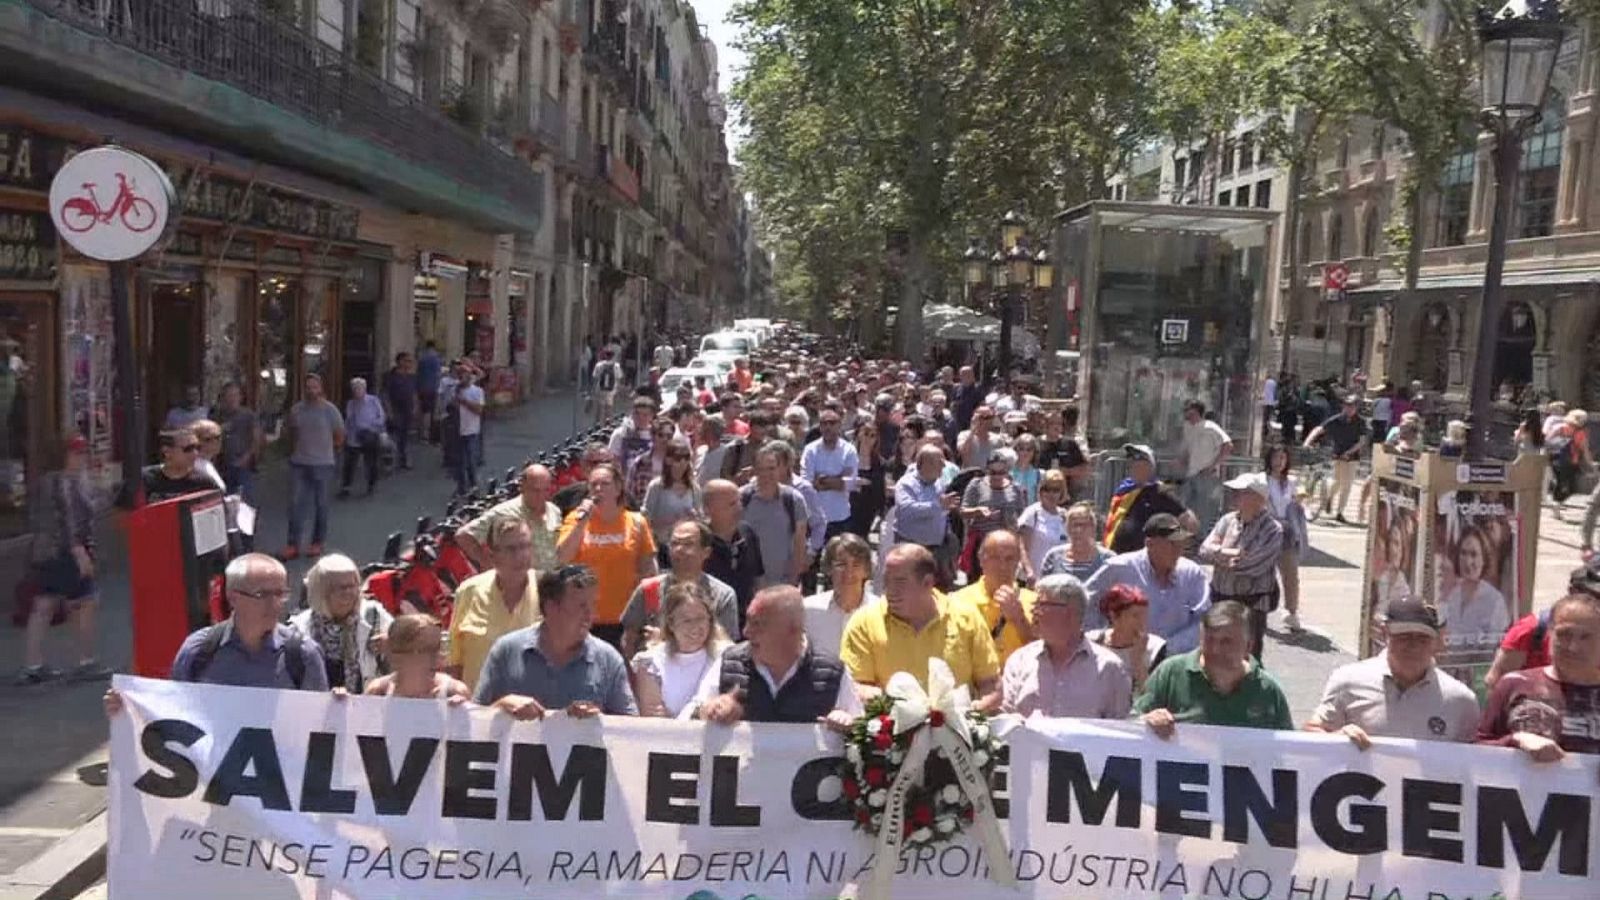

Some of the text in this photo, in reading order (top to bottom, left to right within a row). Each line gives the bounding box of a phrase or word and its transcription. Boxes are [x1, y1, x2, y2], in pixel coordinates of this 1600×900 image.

[134, 719, 1592, 876] SALVEM EL QE MENGEM
[342, 845, 531, 886] PAGESIA,
[549, 849, 791, 883] RAMADERIA
[806, 851, 845, 884] NI
[852, 844, 1189, 894] AGROIDÚSTRIA
[1203, 865, 1272, 900] NO
